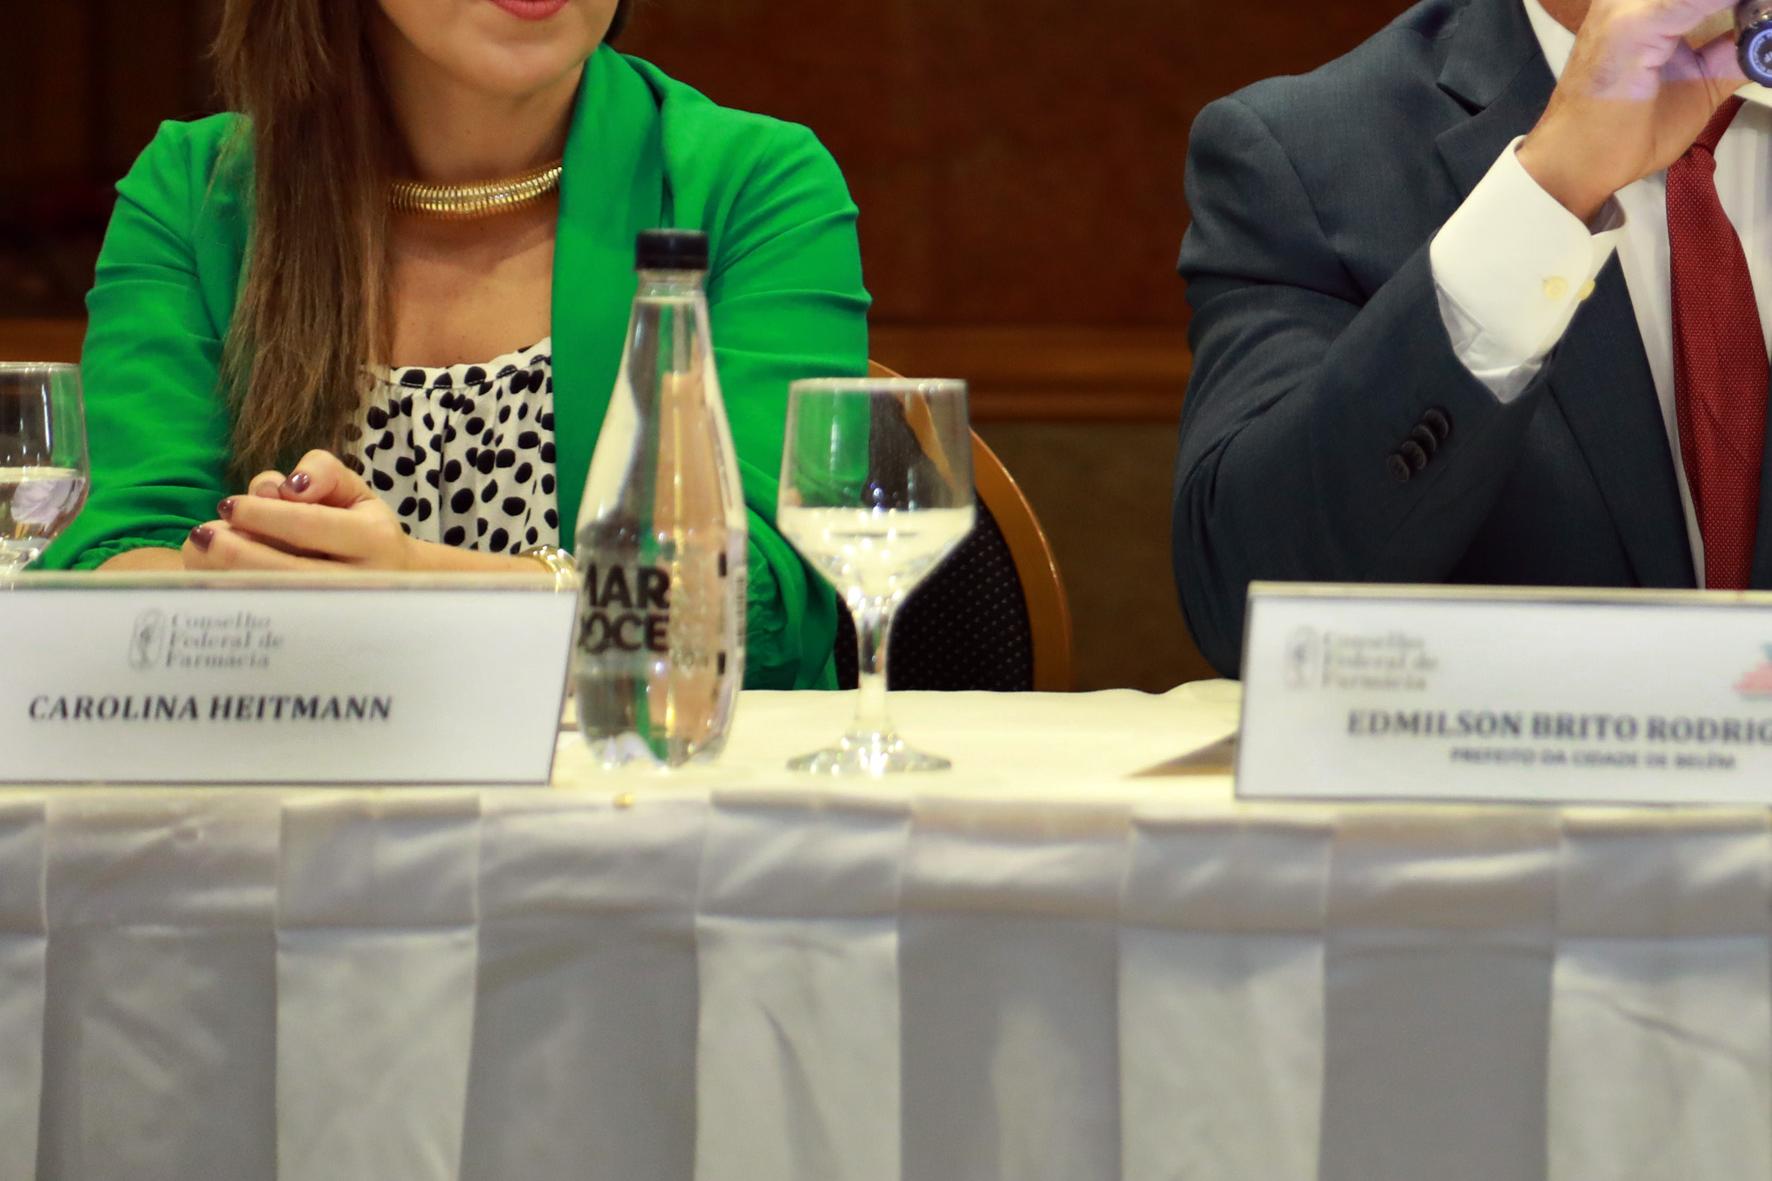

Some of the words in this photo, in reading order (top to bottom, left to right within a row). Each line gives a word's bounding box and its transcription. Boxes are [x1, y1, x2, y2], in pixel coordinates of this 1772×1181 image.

[169, 630, 250, 648] Federal
[258, 630, 284, 648] de
[28, 695, 199, 721] CAROLINA
[209, 695, 393, 722] HEITMANN
[1347, 710, 1522, 738] EDMILSON
[1532, 713, 1639, 741] BRITO
[1542, 749, 1567, 765] DA
